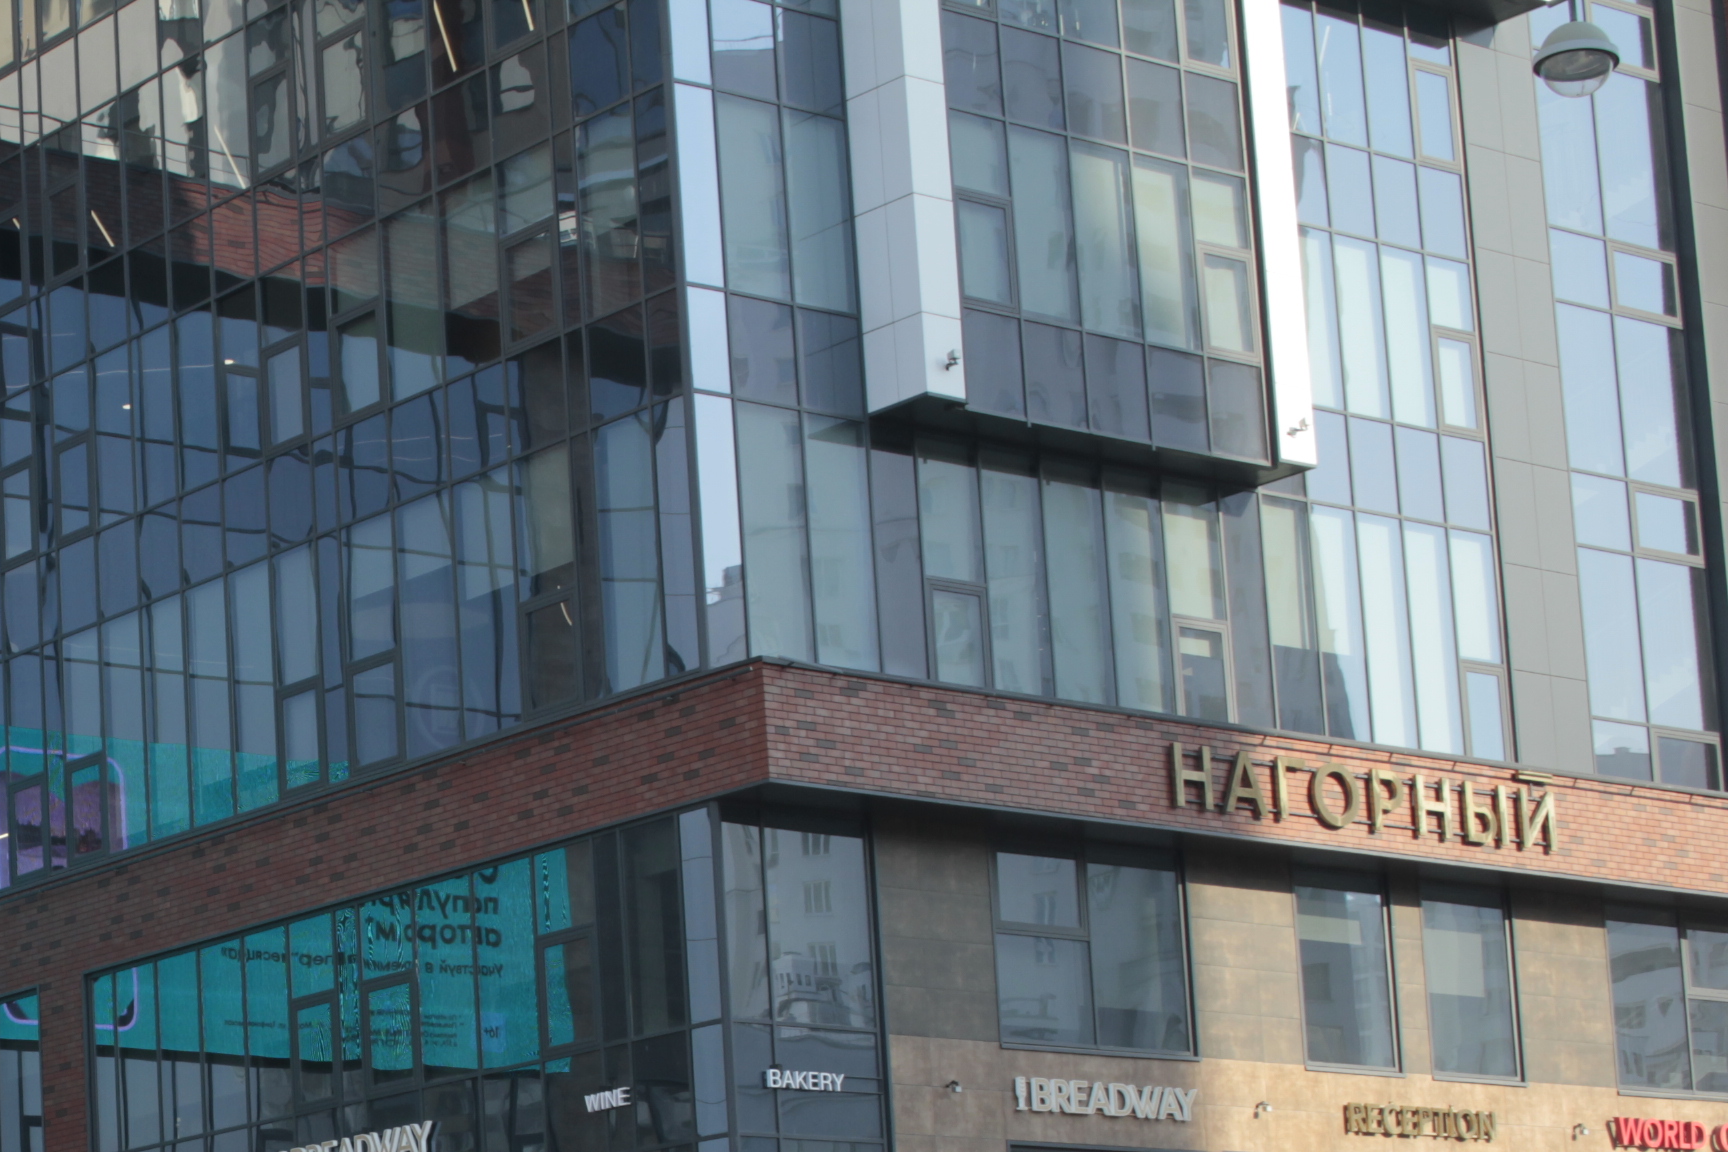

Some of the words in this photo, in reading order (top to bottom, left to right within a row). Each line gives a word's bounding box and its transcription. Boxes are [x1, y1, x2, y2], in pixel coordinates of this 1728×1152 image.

[1171, 741, 1558, 854] НАГОРНЫЙ
[766, 1068, 845, 1092] BAKERY
[584, 1086, 631, 1113] WINE
[1030, 1076, 1198, 1122] BREADWAY
[1346, 1102, 1497, 1140] RECEPTION
[1613, 1116, 1708, 1150] WORLD
